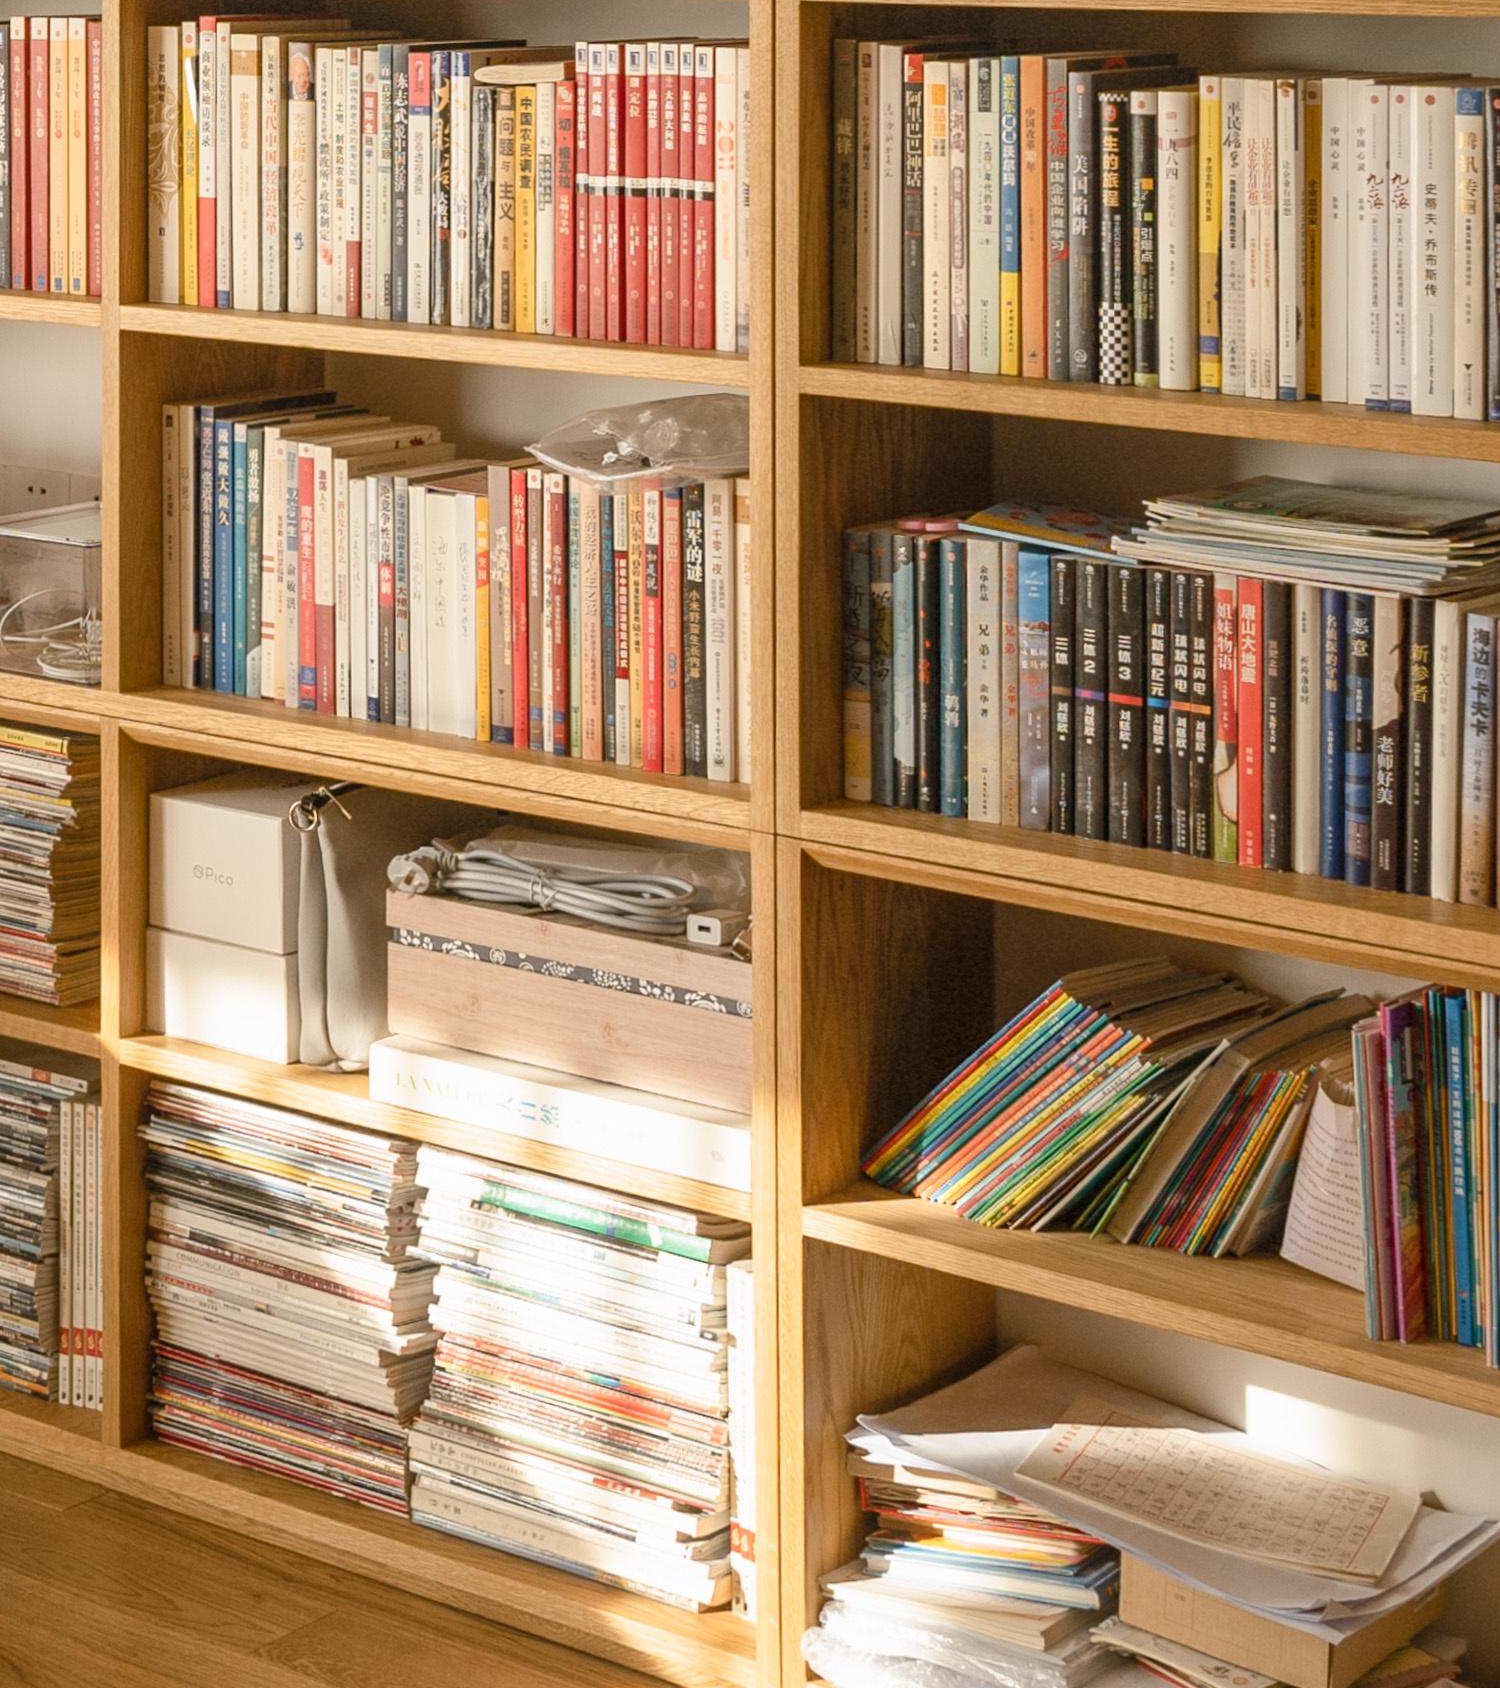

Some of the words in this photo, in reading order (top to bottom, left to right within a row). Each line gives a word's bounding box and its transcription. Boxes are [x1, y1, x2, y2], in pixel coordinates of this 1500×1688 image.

[500, 110, 514, 221] 问题与主义
[520, 97, 532, 189] 中国农民调查
[906, 89, 922, 188] 阿里巴巴神话
[1103, 125, 1119, 208] 一生的旅程
[1072, 154, 1089, 236] 美国陷阱
[1140, 227, 1153, 263] 引爆点
[978, 623, 990, 657] 兄弟
[1055, 637, 1068, 665] 三体
[1151, 622, 1164, 697] 超新星纪元
[1241, 603, 1257, 684] 唐山大地震
[1351, 616, 1368, 657] 恶意
[1411, 644, 1428, 703] 新参者
[1470, 627, 1490, 737] 海边的卡夫卡
[1376, 736, 1394, 806] 老师好美
[206, 871, 234, 887] Pico
